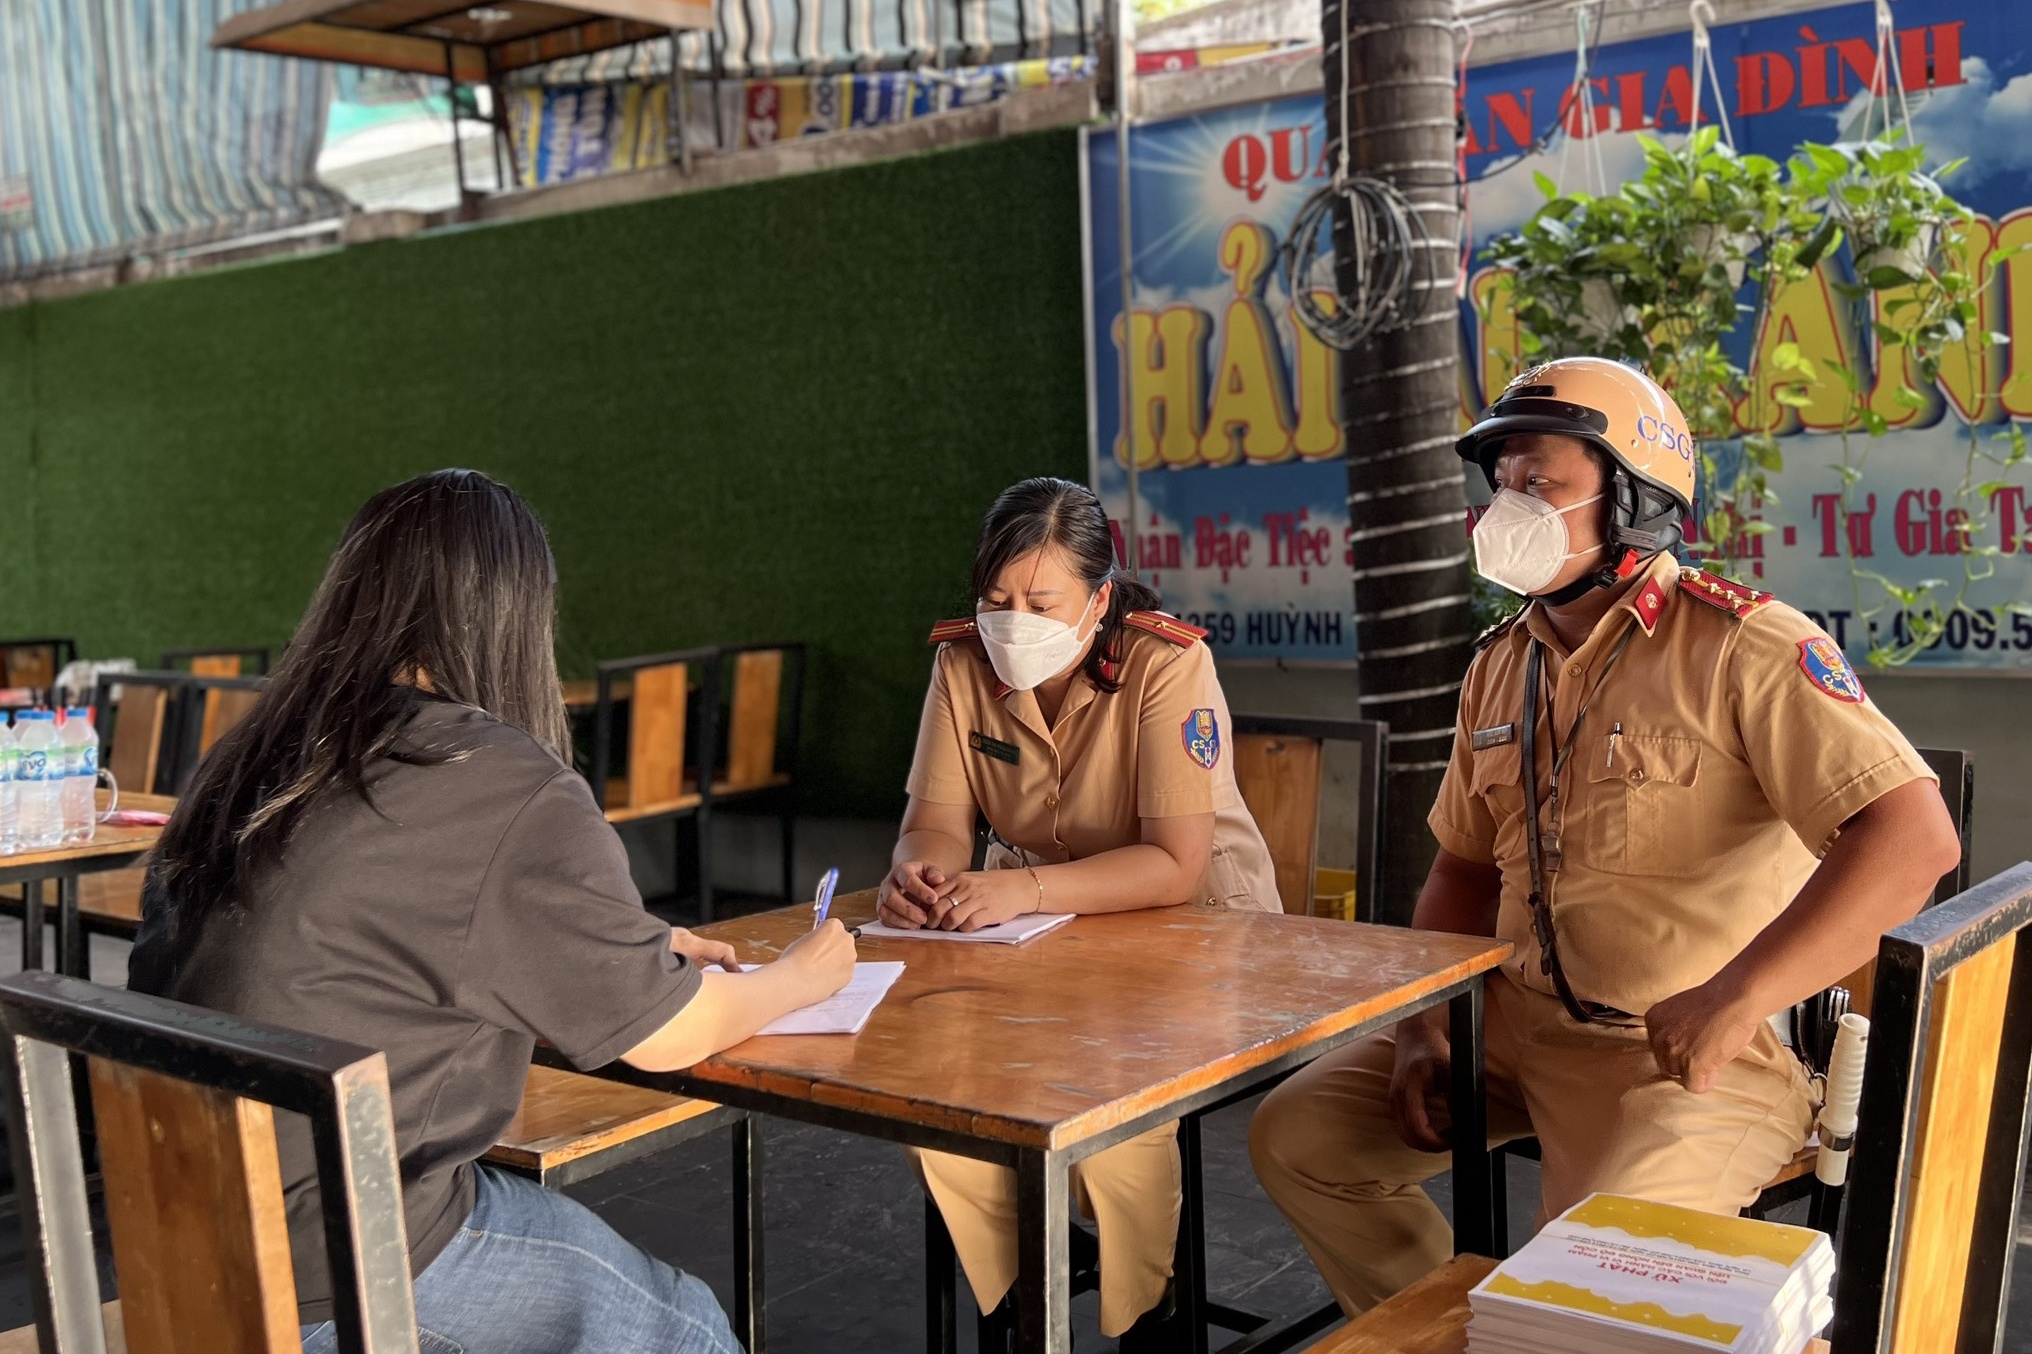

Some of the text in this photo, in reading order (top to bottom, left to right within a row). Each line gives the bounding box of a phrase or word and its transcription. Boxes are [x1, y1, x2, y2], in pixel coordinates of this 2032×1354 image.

[1559, 64, 1708, 139] GIA
[1732, 21, 1967, 117] ĐÌNH
[1637, 415, 1693, 462] CSG
[1263, 507, 1331, 585] Tiệc
[1812, 492, 1877, 559] Tư
[1894, 487, 1973, 558] Gia
[1247, 602, 1342, 647] HUỲNH
